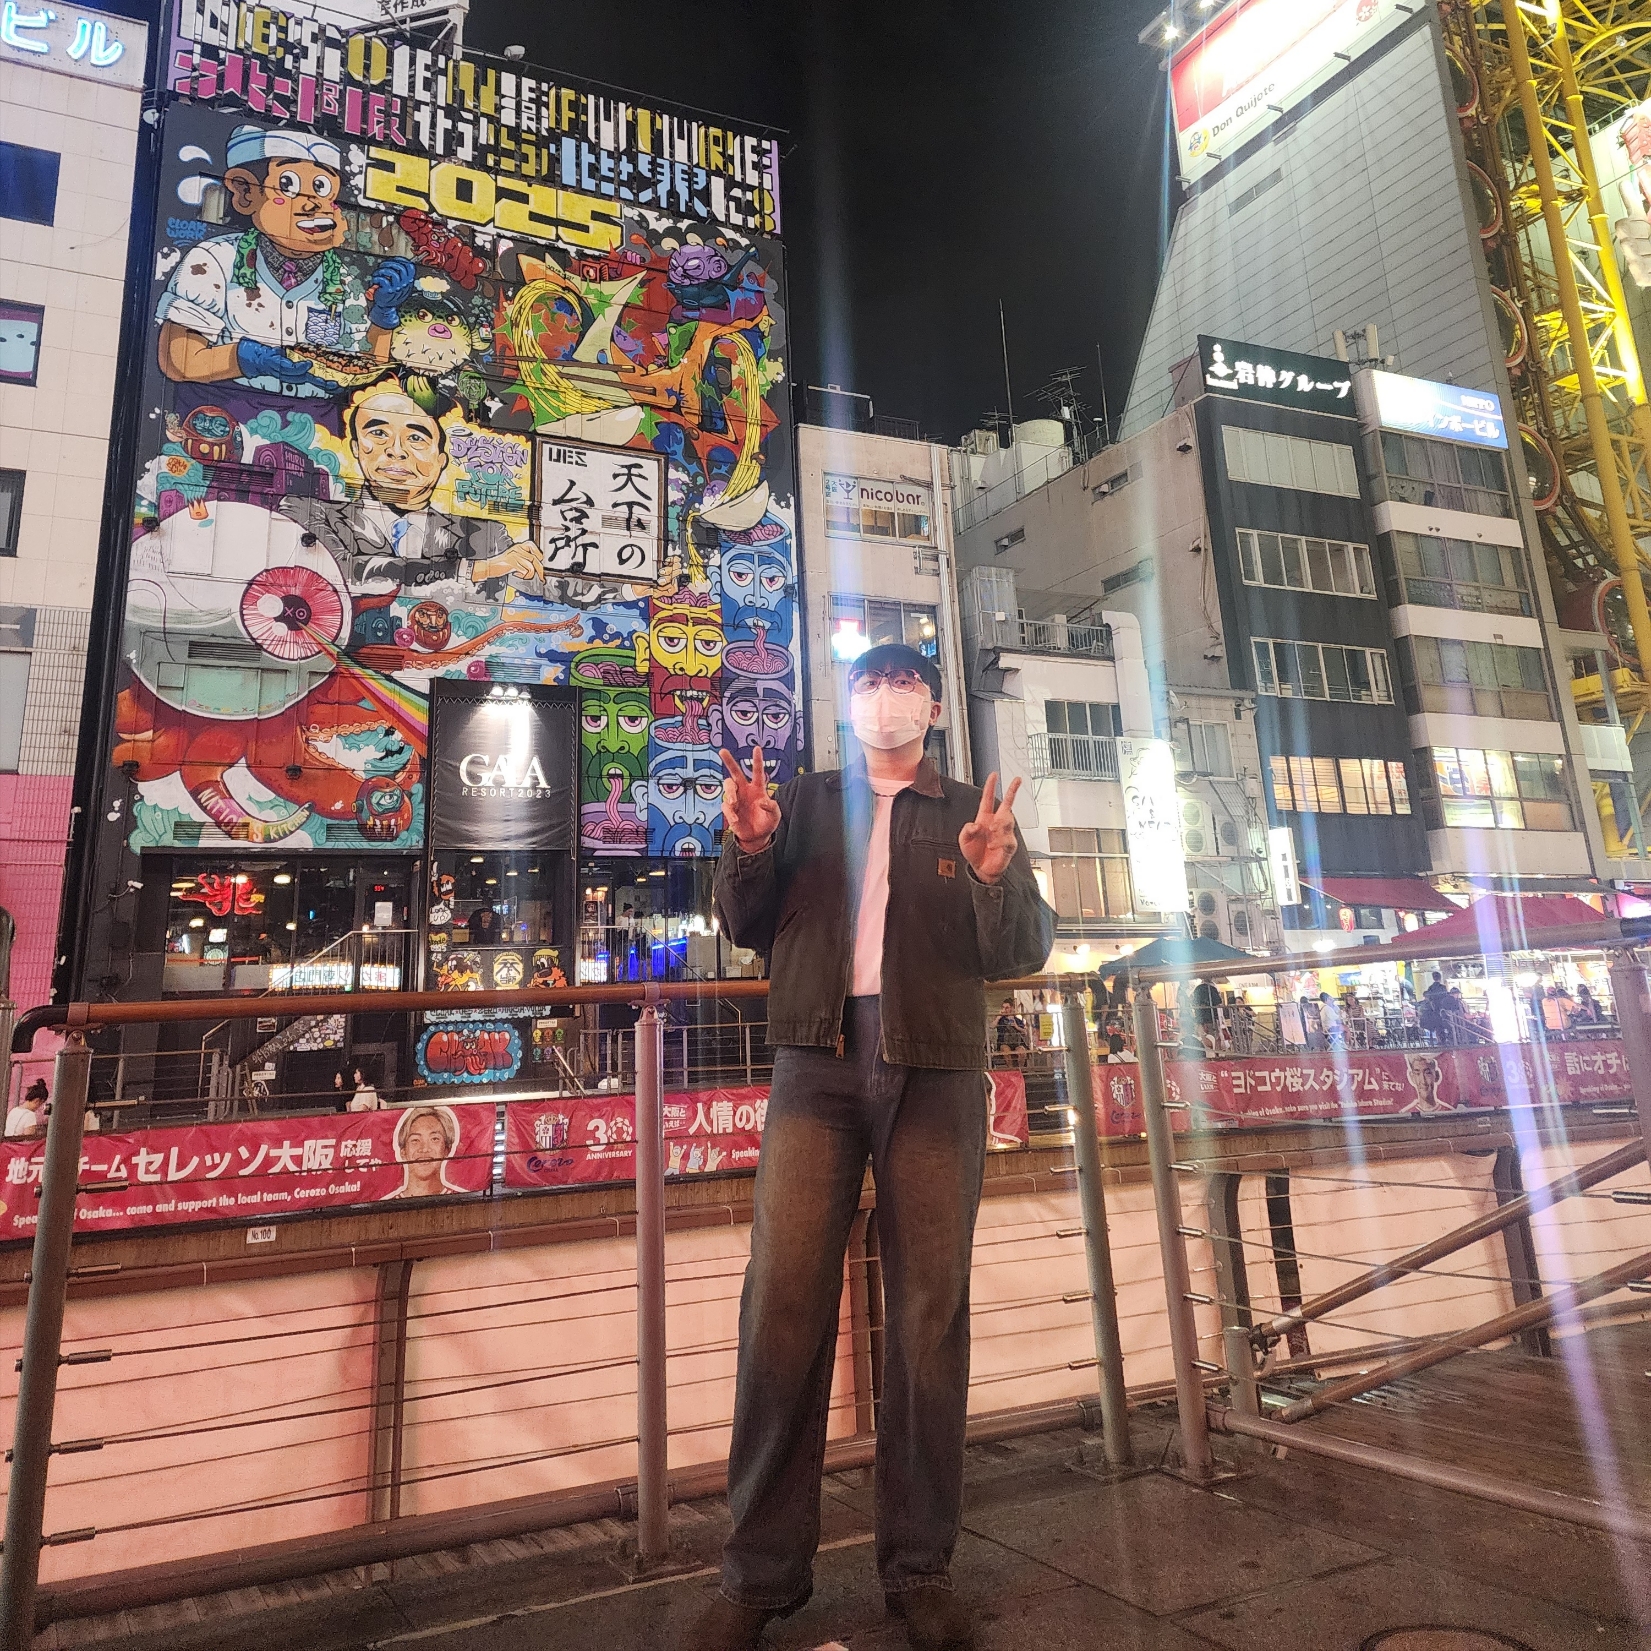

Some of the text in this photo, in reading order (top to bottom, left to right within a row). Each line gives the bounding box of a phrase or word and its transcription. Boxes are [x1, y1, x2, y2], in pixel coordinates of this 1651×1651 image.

[1, 2, 124, 67] ビル
[1212, 82, 1275, 138] Don Quijote
[364, 146, 624, 252] 2025
[449, 436, 528, 468] DESIGN
[463, 460, 516, 488] FOR
[455, 478, 525, 512] FUTURE
[548, 479, 599, 572] 台所
[607, 462, 652, 570] 天下の
[269, 808, 310, 840] KITCHEN
[131, 1138, 336, 1183] セレッソ大阪
[340, 1138, 372, 1158] 応援
[586, 1150, 632, 1161] ANNIVERSARY
[732, 1147, 760, 1160] Speakin
[79, 1204, 123, 1220] Osaka...
[126, 1205, 153, 1216] come
[155, 1199, 175, 1213] and
[177, 1197, 217, 1212] support
[218, 1194, 236, 1207] the
[238, 1190, 261, 1205] local
[262, 1191, 291, 1202] team,
[294, 1186, 327, 1199] Cerezo
[328, 1180, 361, 1194] Osaka!
